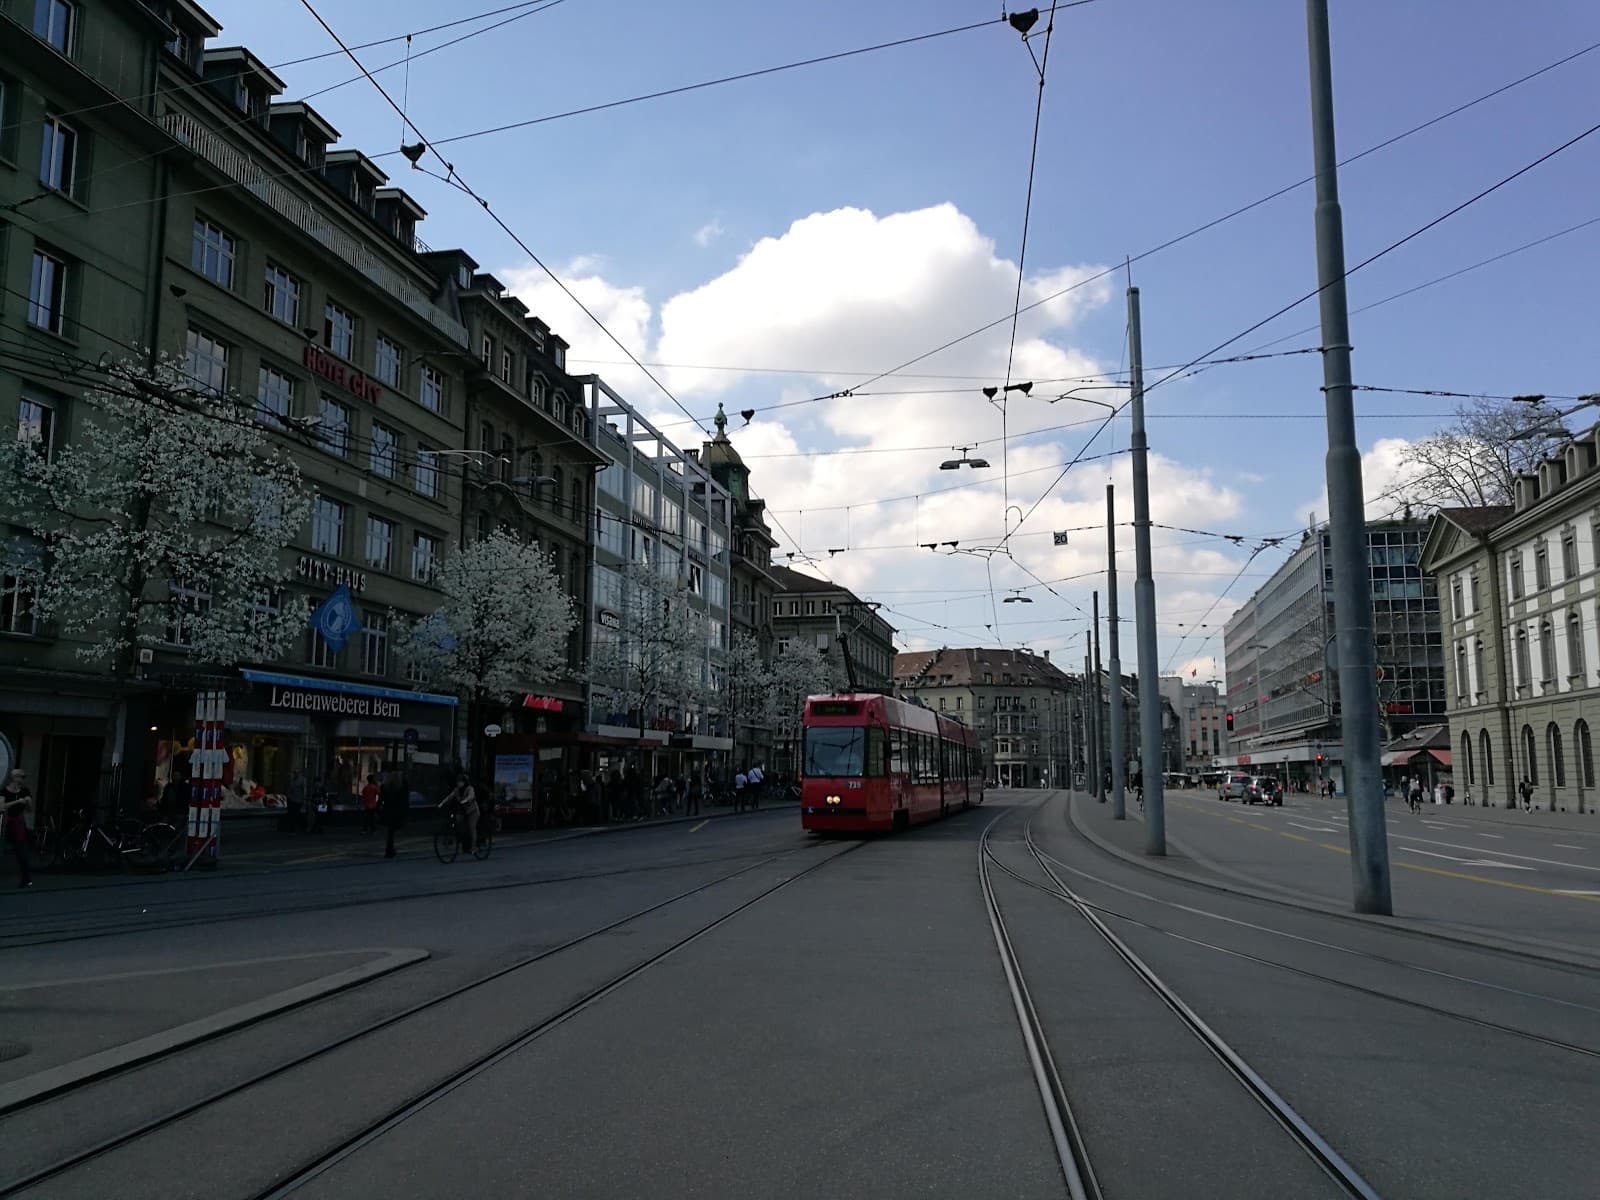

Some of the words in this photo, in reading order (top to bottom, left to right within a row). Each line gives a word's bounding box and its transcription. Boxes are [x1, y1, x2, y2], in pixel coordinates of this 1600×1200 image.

[304, 347, 345, 386] HOTEL
[299, 556, 366, 592] CITY-HAUS
[270, 685, 370, 715] Leinenweberei
[373, 697, 401, 718] Bern
